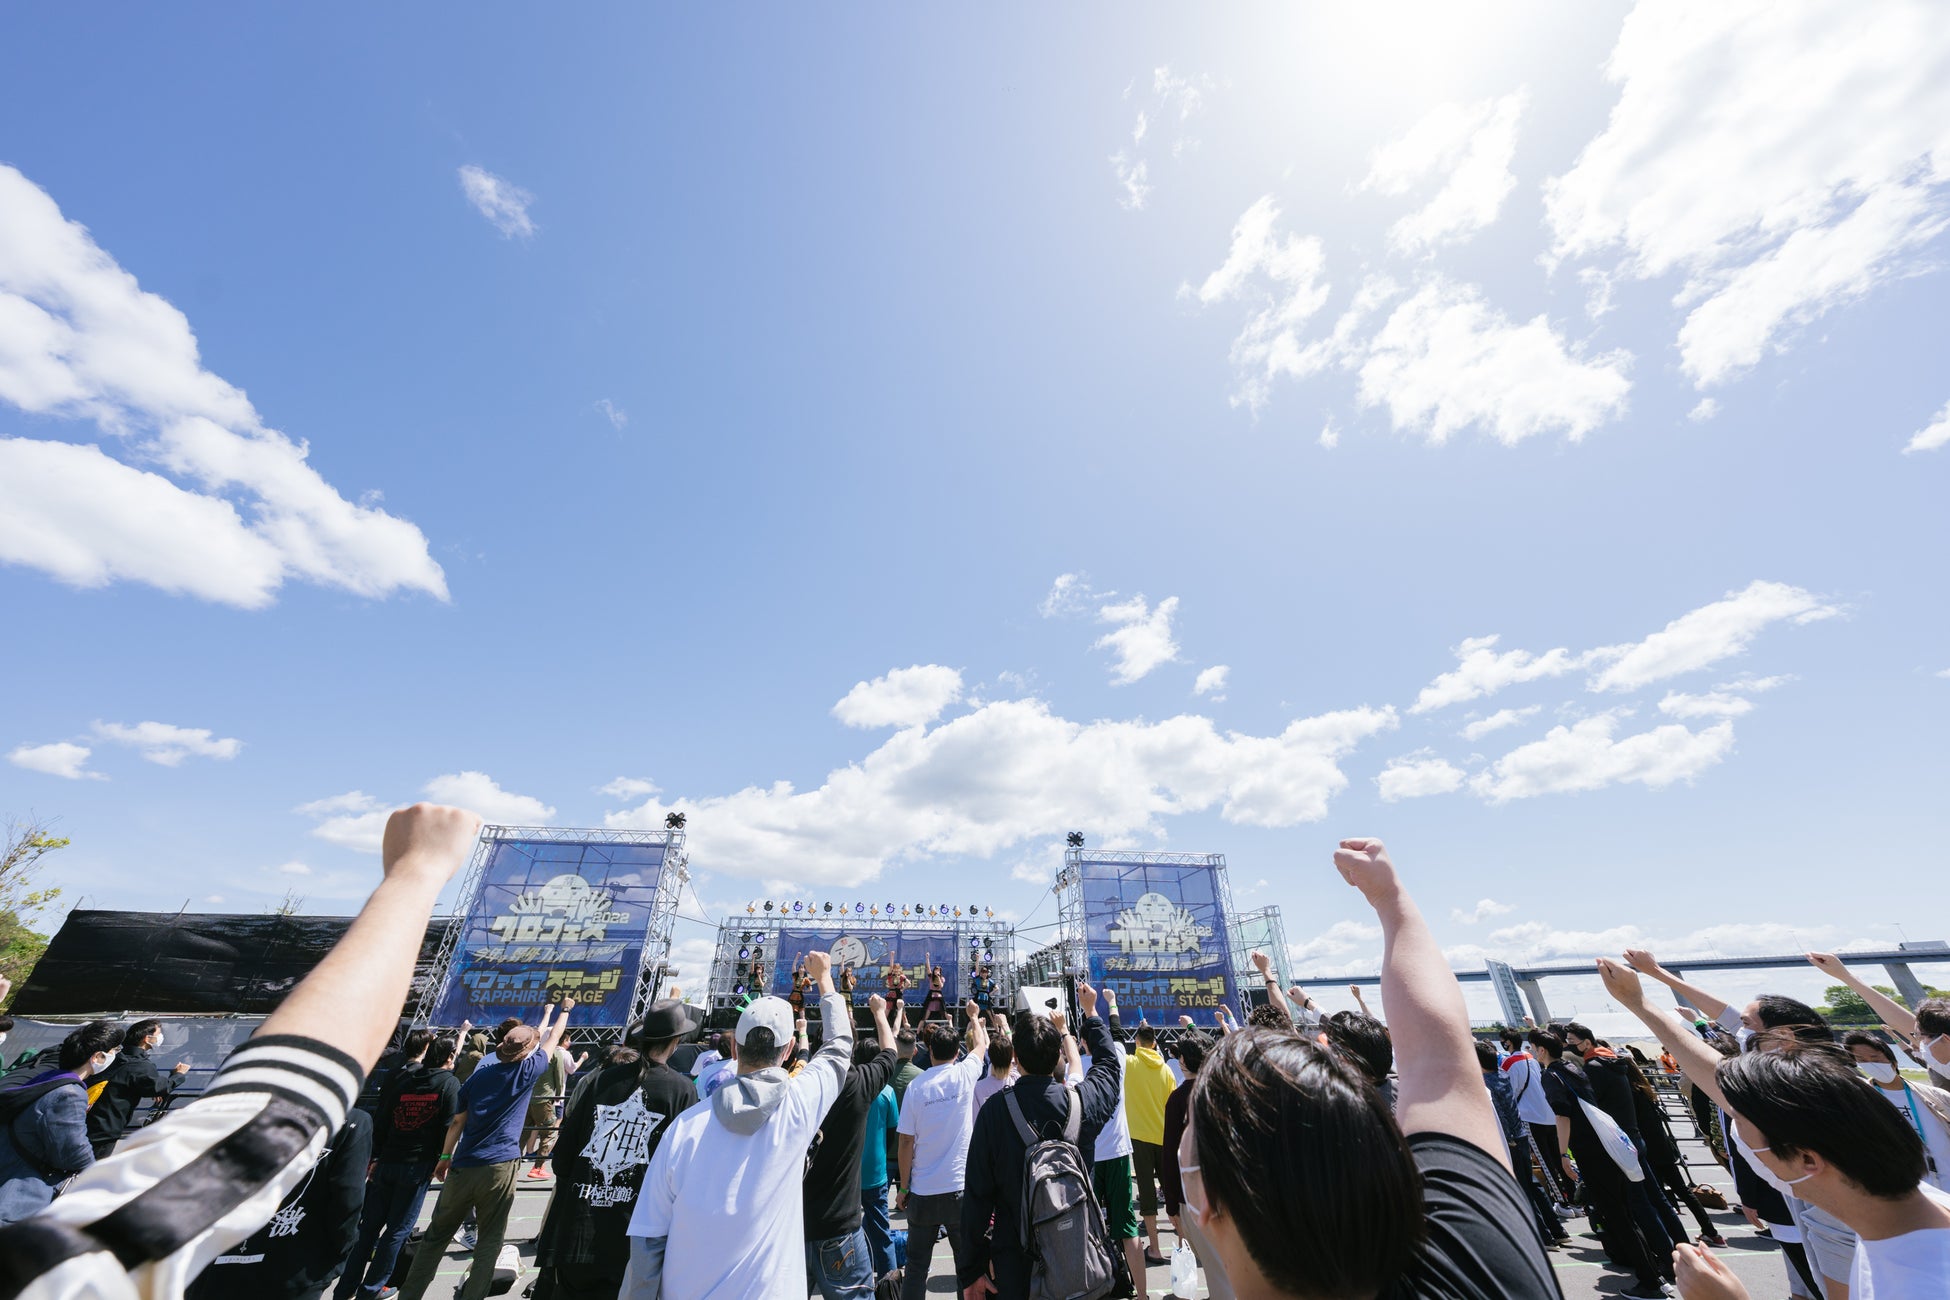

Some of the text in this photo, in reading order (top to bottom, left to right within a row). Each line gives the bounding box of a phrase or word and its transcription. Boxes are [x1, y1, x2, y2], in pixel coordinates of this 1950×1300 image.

[592, 911, 630, 924] 2022
[470, 989, 604, 1003] SAPPHIRE STAGE
[1117, 994, 1219, 1007] SAPPHIRE STAGE
[600, 1110, 647, 1164] 神
[579, 1183, 634, 1202] 日本武道館
